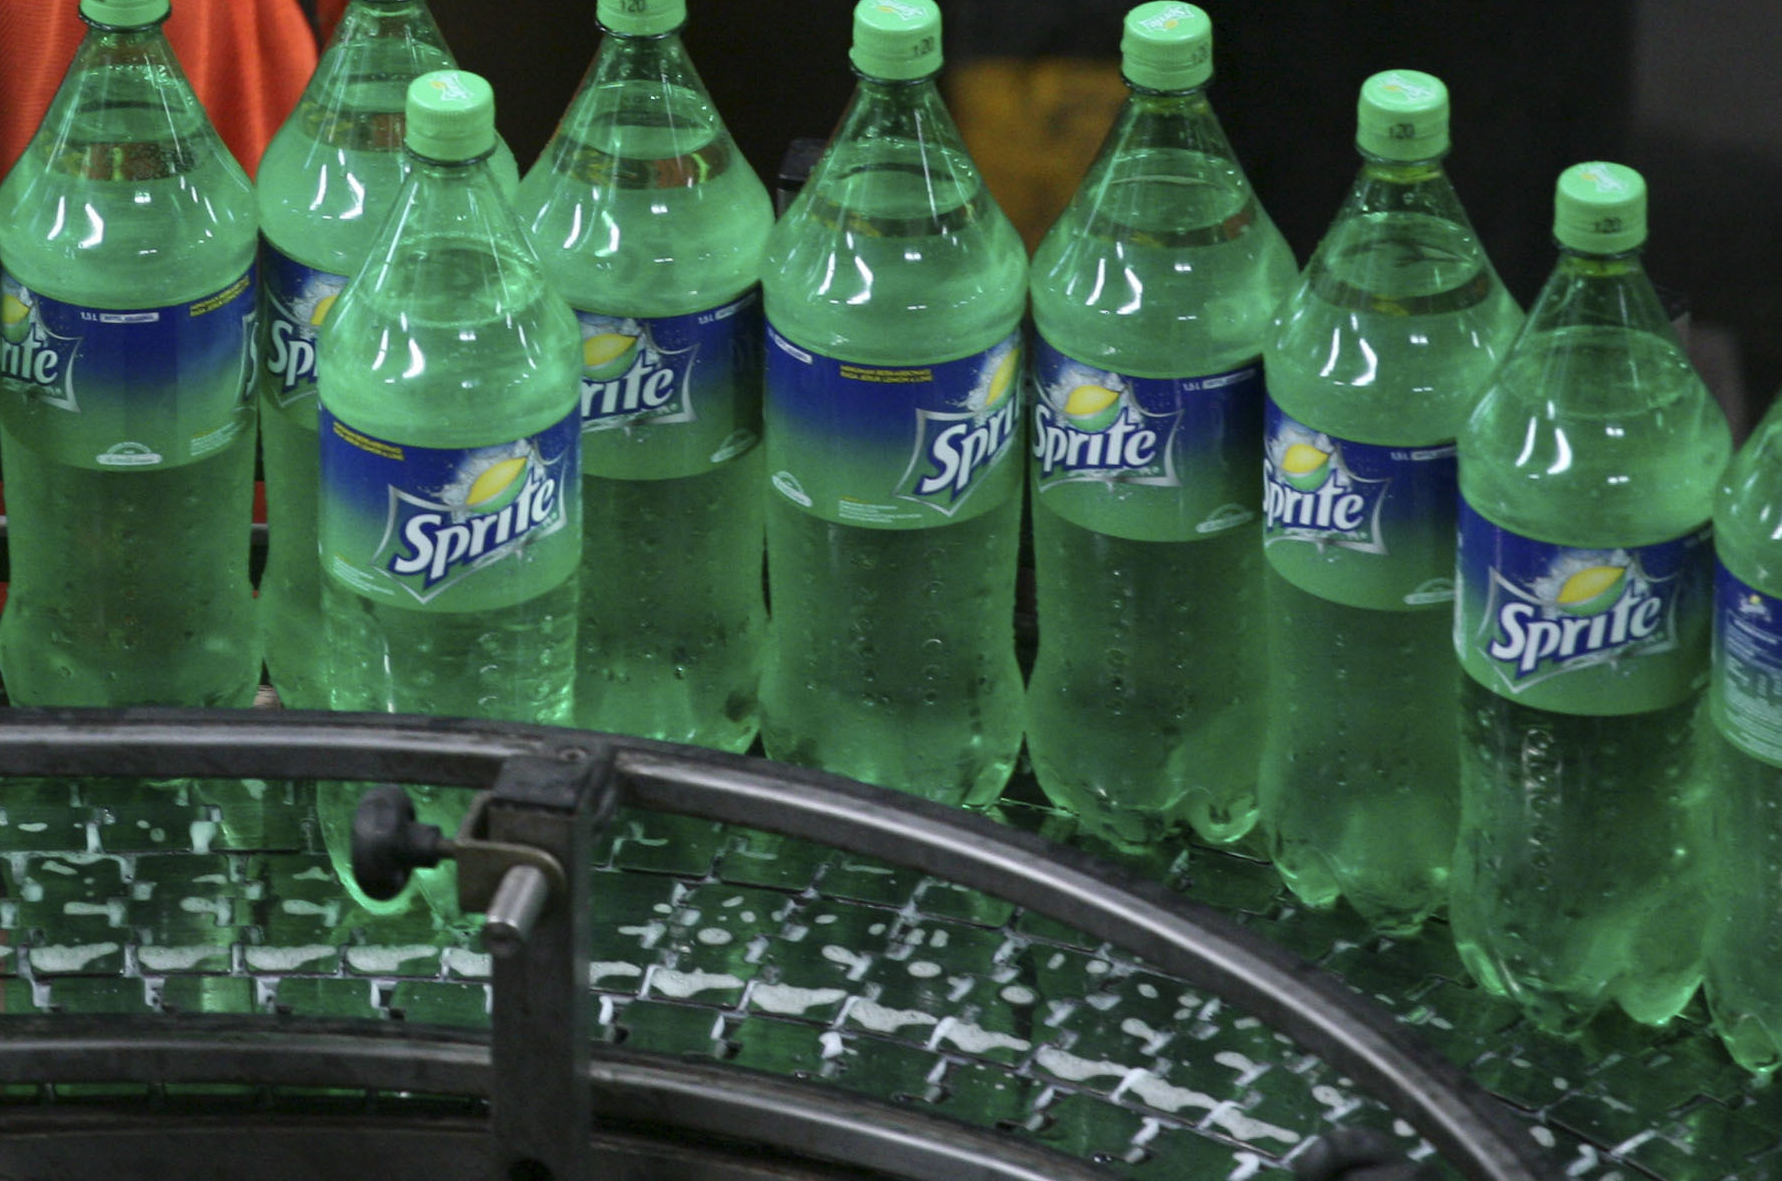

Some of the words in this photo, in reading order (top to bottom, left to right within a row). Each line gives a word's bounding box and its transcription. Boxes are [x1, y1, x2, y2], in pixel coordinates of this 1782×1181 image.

[1389, 122, 1416, 140] 120
[1, 330, 58, 384] rite
[581, 354, 674, 417] rite
[921, 389, 1017, 494] Spri
[1033, 404, 1156, 472] Sprite
[394, 473, 555, 580] Sprite
[1490, 586, 1661, 672] Sprite
